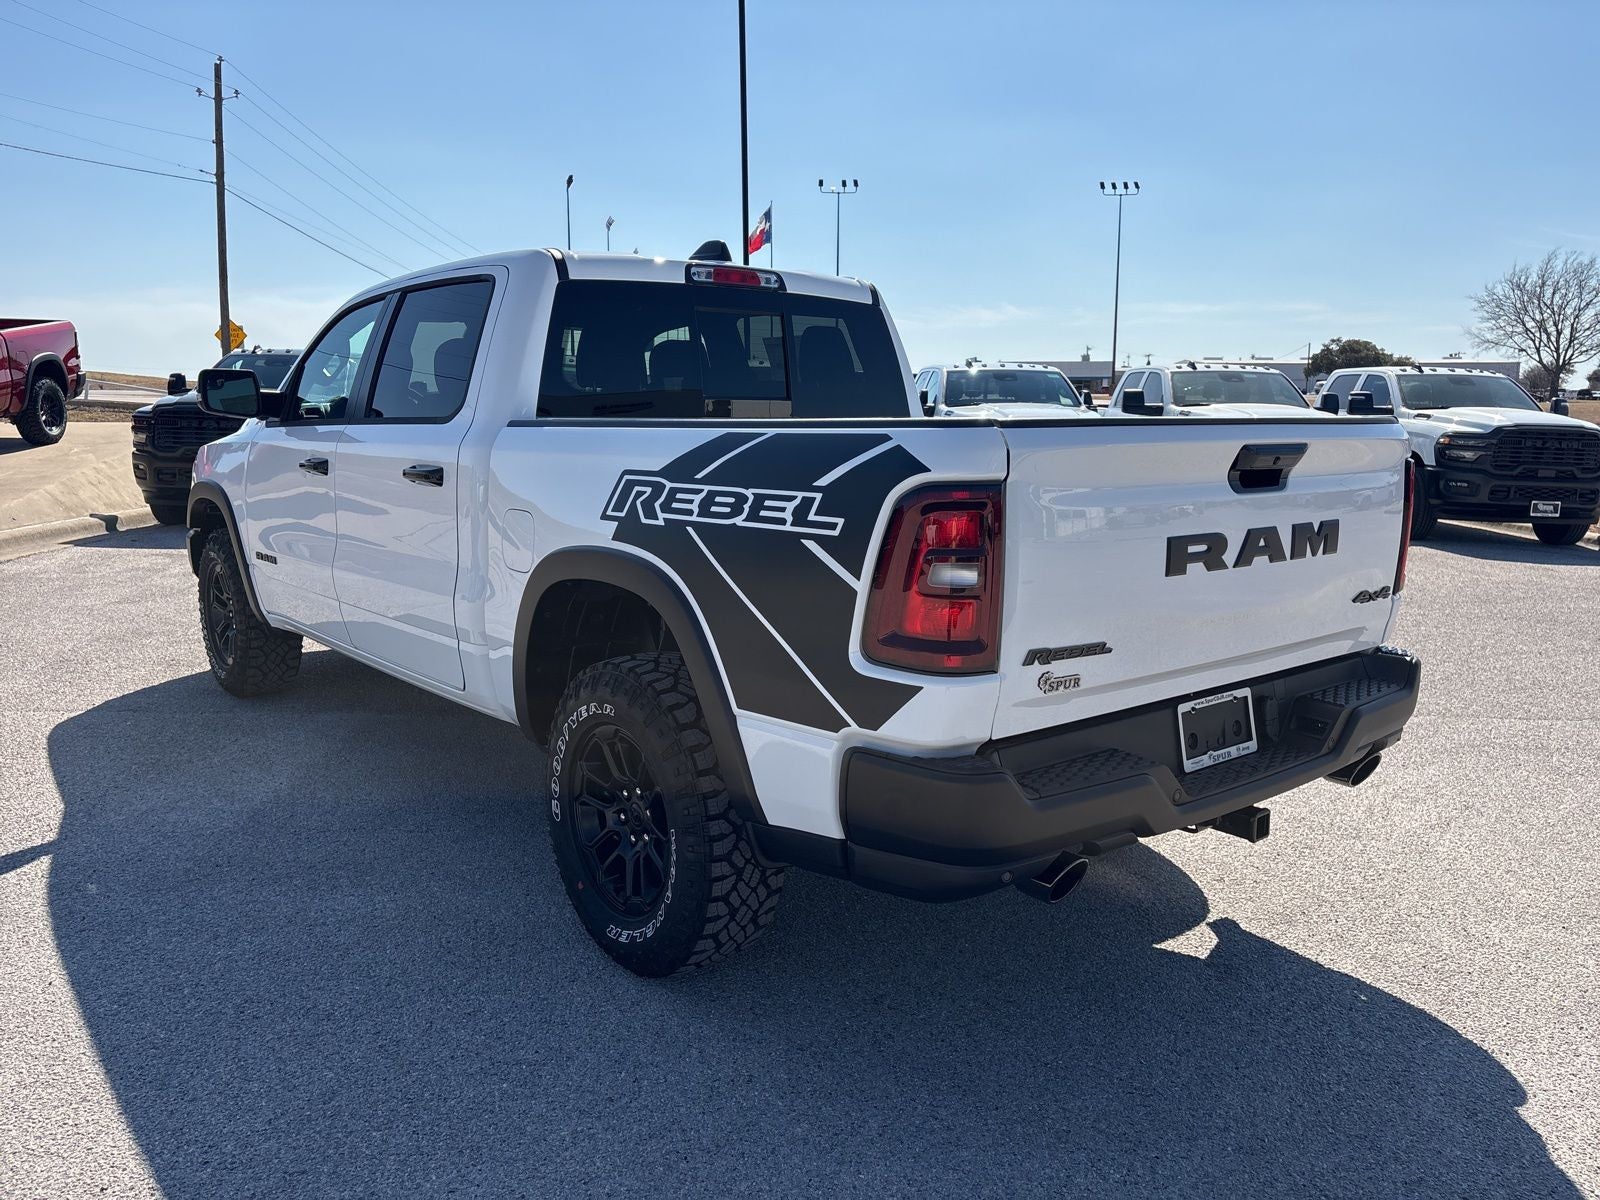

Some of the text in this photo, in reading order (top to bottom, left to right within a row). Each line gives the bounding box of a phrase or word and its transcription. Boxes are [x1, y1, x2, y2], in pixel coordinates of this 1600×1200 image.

[606, 475, 845, 536] REBEL
[255, 551, 278, 565] RAM
[1165, 519, 1340, 577] RAM
[1351, 586, 1391, 604] 4x4
[1022, 641, 1113, 666] REBEL
[1048, 678, 1081, 692] SPUR
[551, 702, 616, 822] GOODYEAR
[1212, 751, 1232, 763] SPUR
[606, 829, 676, 943] WRANGLER
